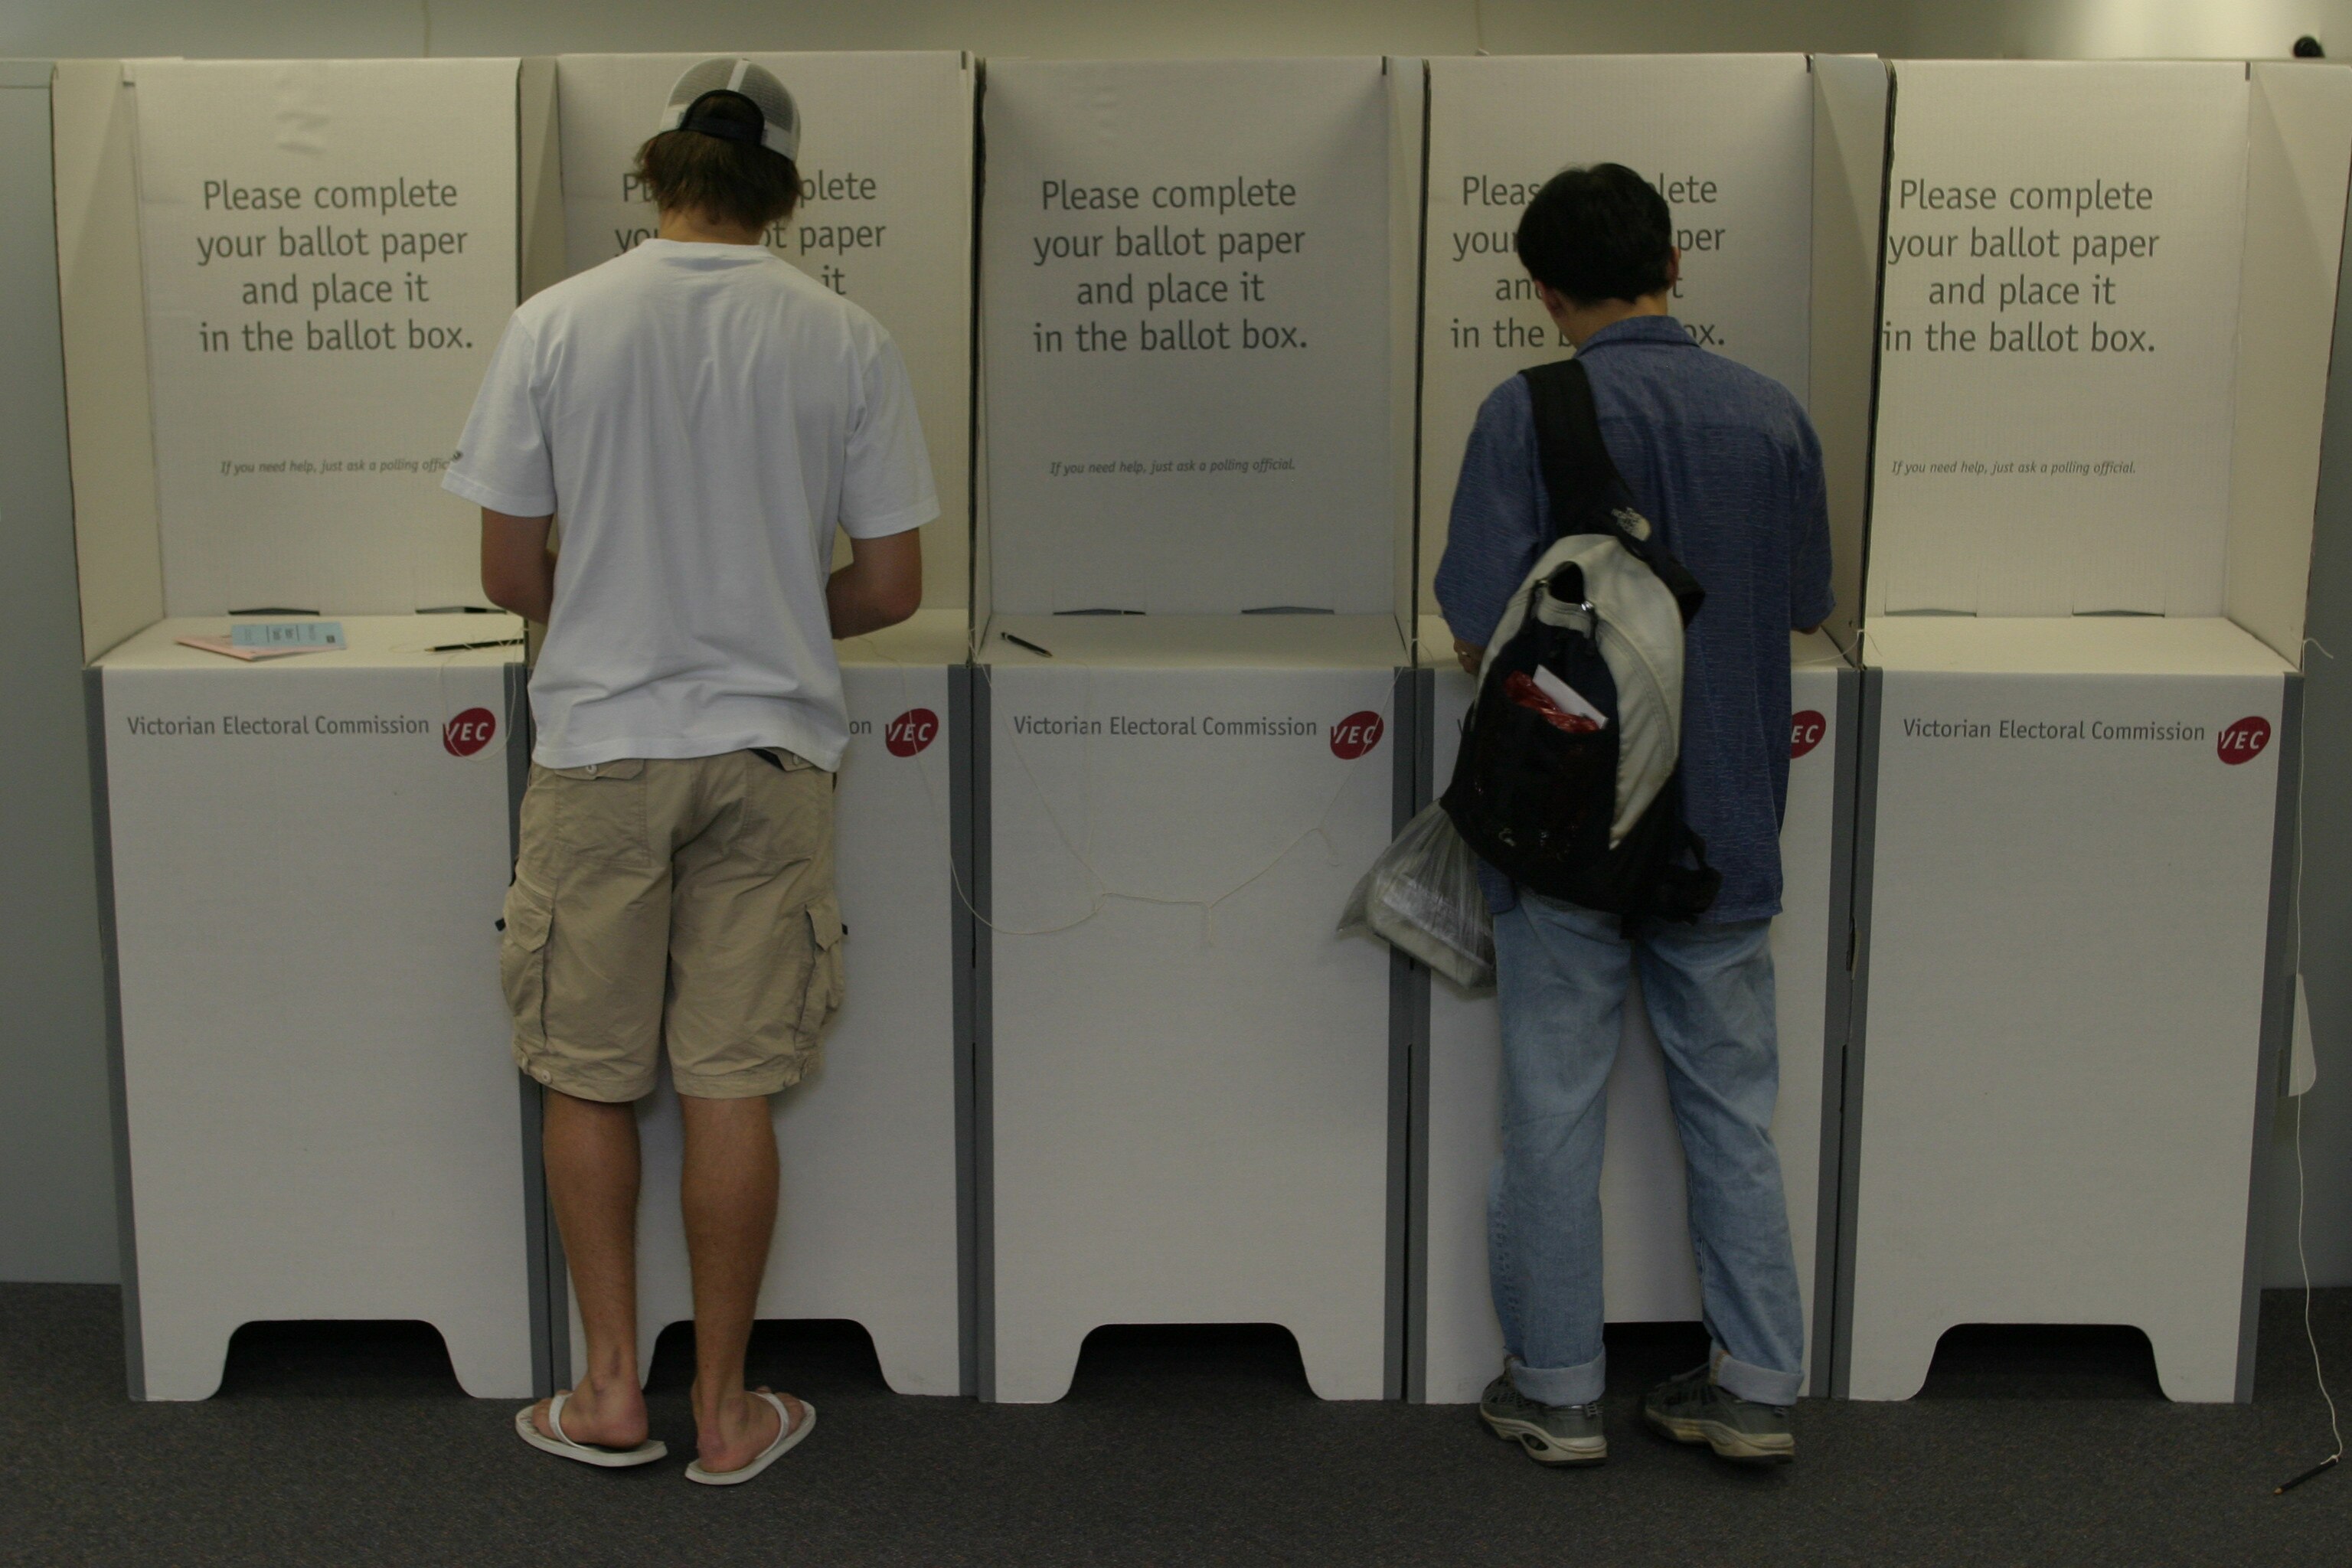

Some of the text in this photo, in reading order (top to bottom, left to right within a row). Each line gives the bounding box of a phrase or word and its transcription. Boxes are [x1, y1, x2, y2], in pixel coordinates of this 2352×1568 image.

[204, 177, 456, 215] Please complete
[1043, 176, 1295, 215] Please complete
[1462, 175, 1542, 206] Pleas
[1901, 178, 2152, 217] Please complete
[197, 226, 467, 266] your ballot paper
[799, 226, 886, 256] paper
[1034, 225, 1305, 266] your ballot paper
[1675, 228, 1726, 250] per
[1887, 227, 2159, 265] your ballot paper
[243, 272, 429, 311] and place it
[1077, 272, 1265, 311] and place it
[1929, 274, 2115, 312] and place it
[200, 319, 472, 351] in the ballot box.
[1034, 318, 1306, 352] in the ballot box.
[1451, 318, 1478, 348] in
[1494, 318, 1544, 348] the
[1883, 321, 2154, 351] in the ballot box.
[221, 457, 450, 475] If you need help, just ask a polling offic
[1050, 458, 1295, 476] If you need help, just ask a polling official.
[1892, 461, 2135, 475] If you need help, just ask a polling official.
[127, 715, 429, 735] Victorian Electoral Commission
[445, 722, 488, 741] VEC
[885, 723, 931, 741] VEC
[1014, 716, 1317, 736] Victorian Electoral Commission
[1331, 726, 1376, 744] VEC
[1791, 725, 1818, 743] EC
[1904, 718, 2204, 740] Victorian Electoral Commission
[2220, 731, 2263, 750] VEC
